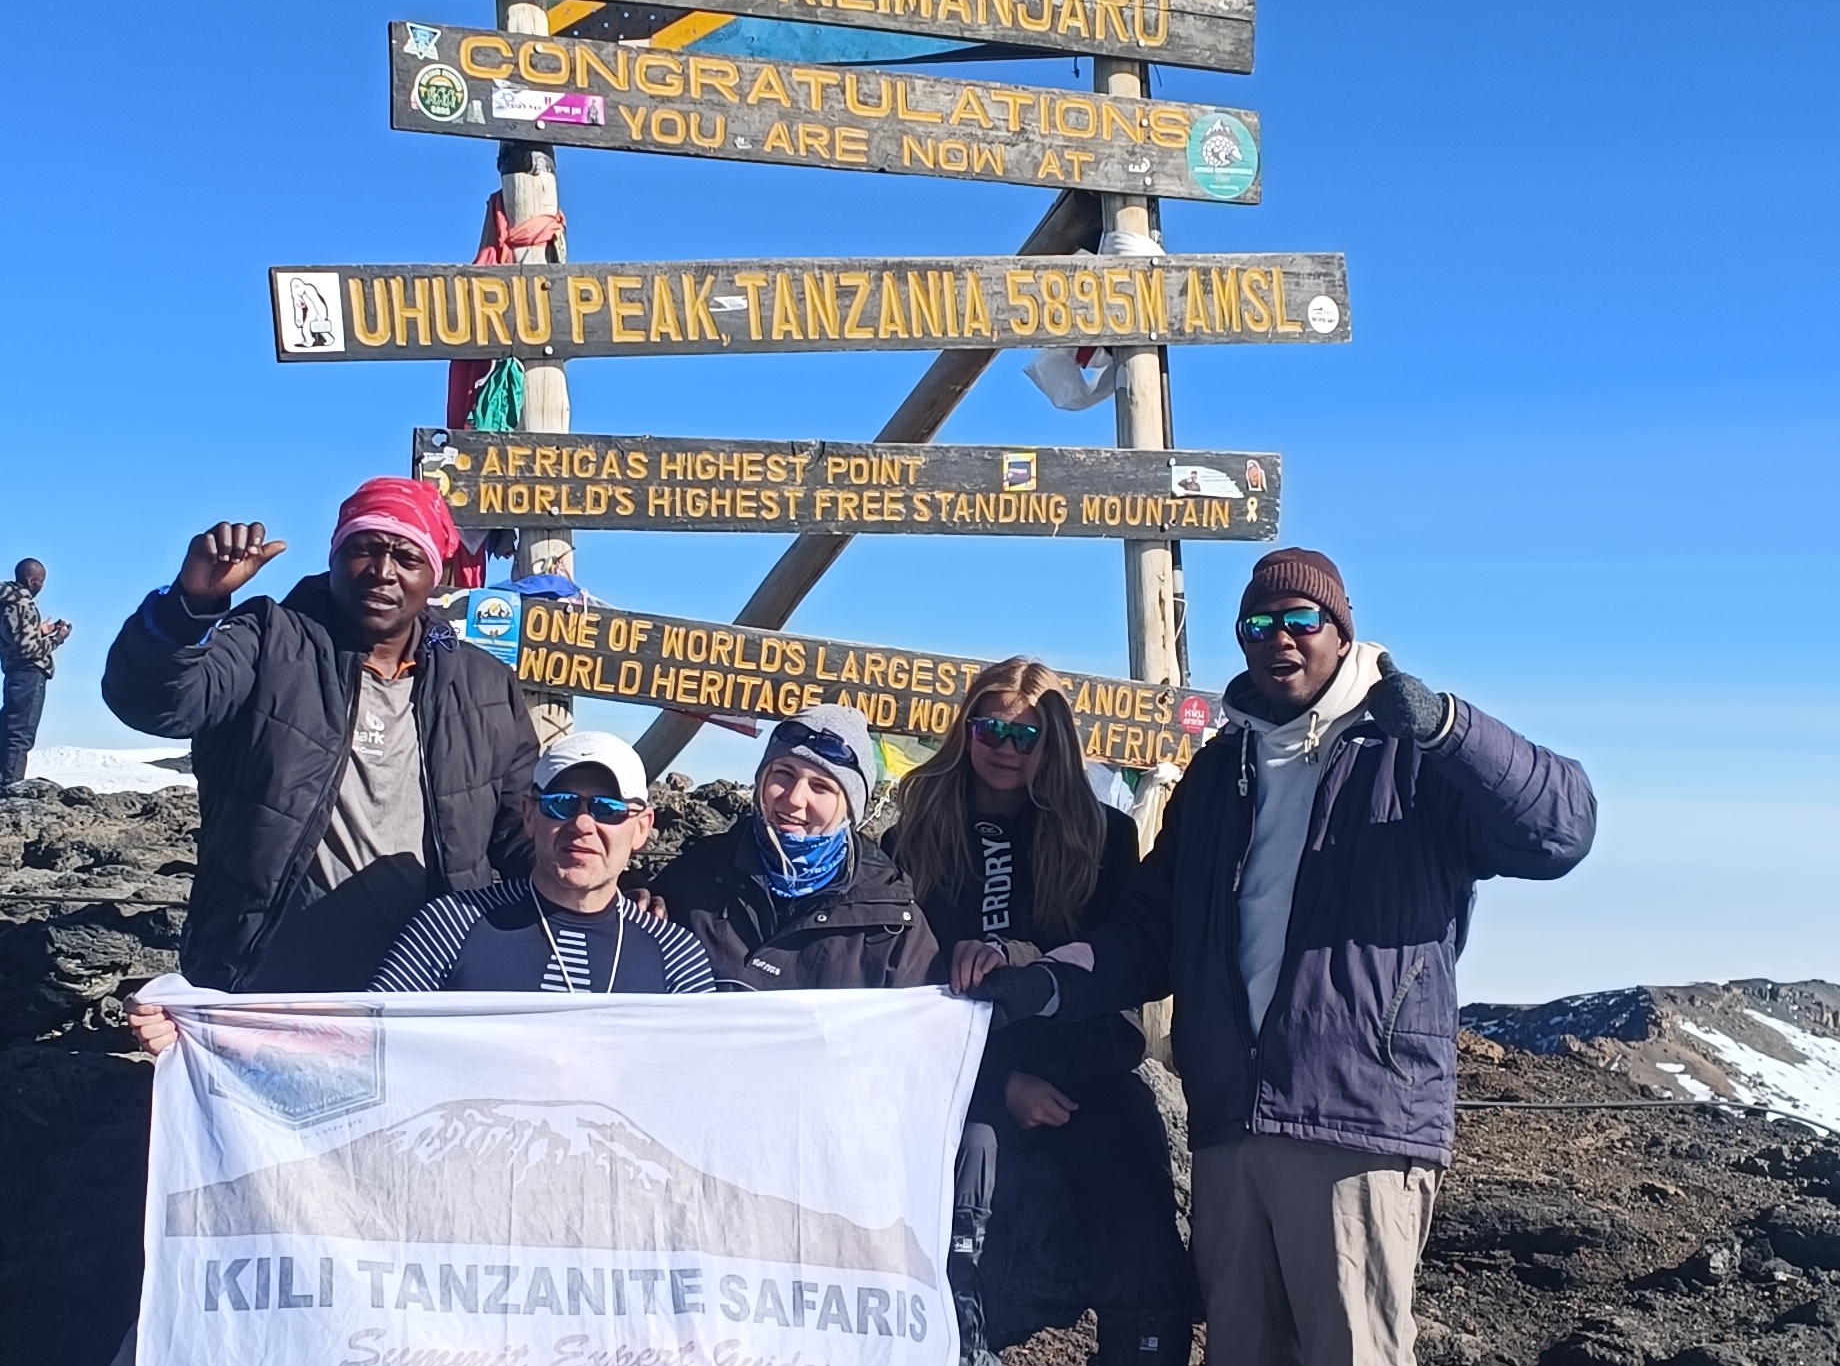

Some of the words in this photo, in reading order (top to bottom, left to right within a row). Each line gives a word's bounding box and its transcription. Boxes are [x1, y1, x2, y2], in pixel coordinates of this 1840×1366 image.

[459, 35, 1191, 148] CONGRATULATIONS
[619, 105, 726, 149] YOU
[763, 121, 868, 164] ARE
[903, 135, 1005, 177] NOW
[1038, 149, 1095, 183] AT
[348, 276, 552, 347] UHURU
[567, 273, 730, 347] PEAK,
[1006, 267, 1168, 336] 5895M
[1185, 265, 1304, 334] AMSL
[479, 483, 636, 517] WORLD'S
[648, 486, 804, 520] HIGHEST
[815, 489, 905, 522] FREE
[913, 491, 1068, 525] STANDING
[1082, 493, 1231, 529] MOUNTAIN
[480, 446, 649, 480] AFRICAS
[661, 452, 811, 483] HIGHEST
[827, 456, 925, 485] POINT
[519, 647, 643, 695] WORLD
[650, 664, 824, 716] HERITAGE
[837, 689, 898, 728] AND
[1086, 721, 1192, 766] AFRICA
[526, 605, 601, 649] ONE
[608, 618, 653, 654] OF
[661, 624, 807, 675] WORLD'S
[816, 646, 981, 696] LARGEST
[1060, 678, 1175, 725] ANOES
[974, 821, 1013, 933] ERDRY®
[204, 1256, 334, 1312] KILI
[357, 1260, 706, 1317] TANZANITE
[719, 1274, 928, 1343] SAFARIS
